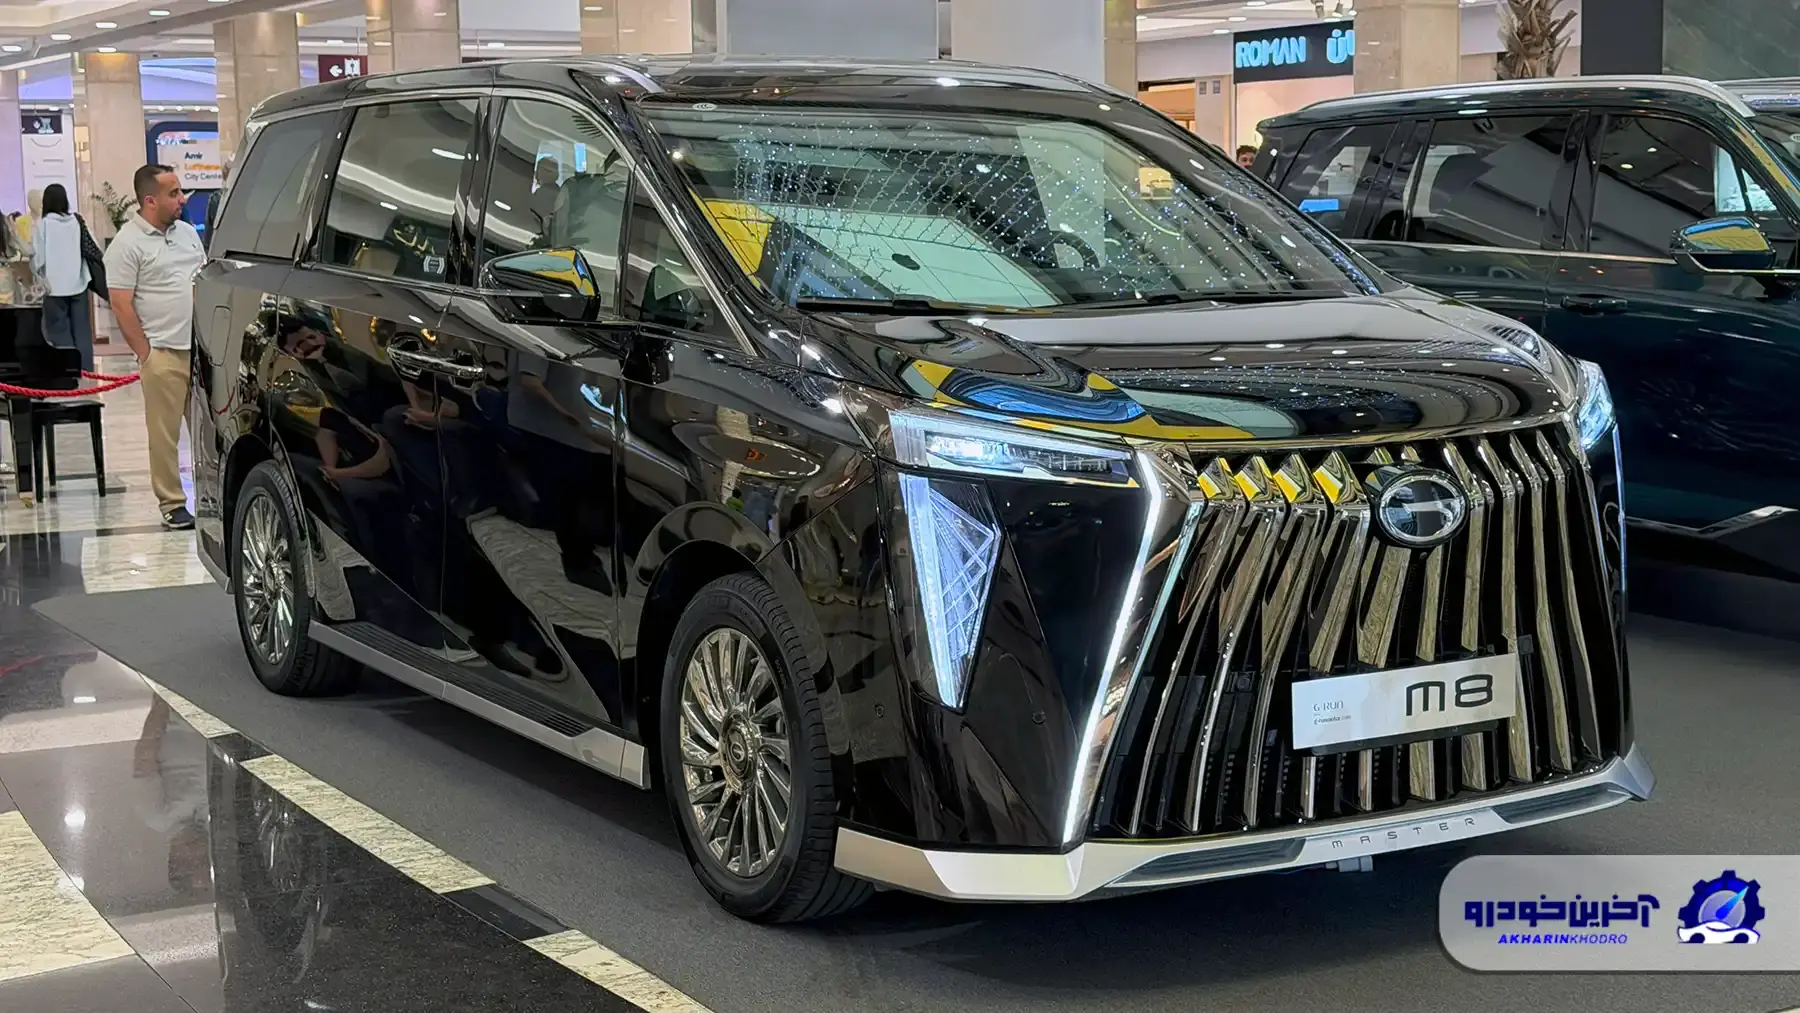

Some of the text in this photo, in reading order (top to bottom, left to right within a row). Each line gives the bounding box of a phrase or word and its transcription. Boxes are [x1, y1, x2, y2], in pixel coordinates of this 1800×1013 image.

[1235, 36, 1306, 68] ROMAN
[184, 172, 222, 182] City Cente
[1331, 817, 1475, 849] MASTER
